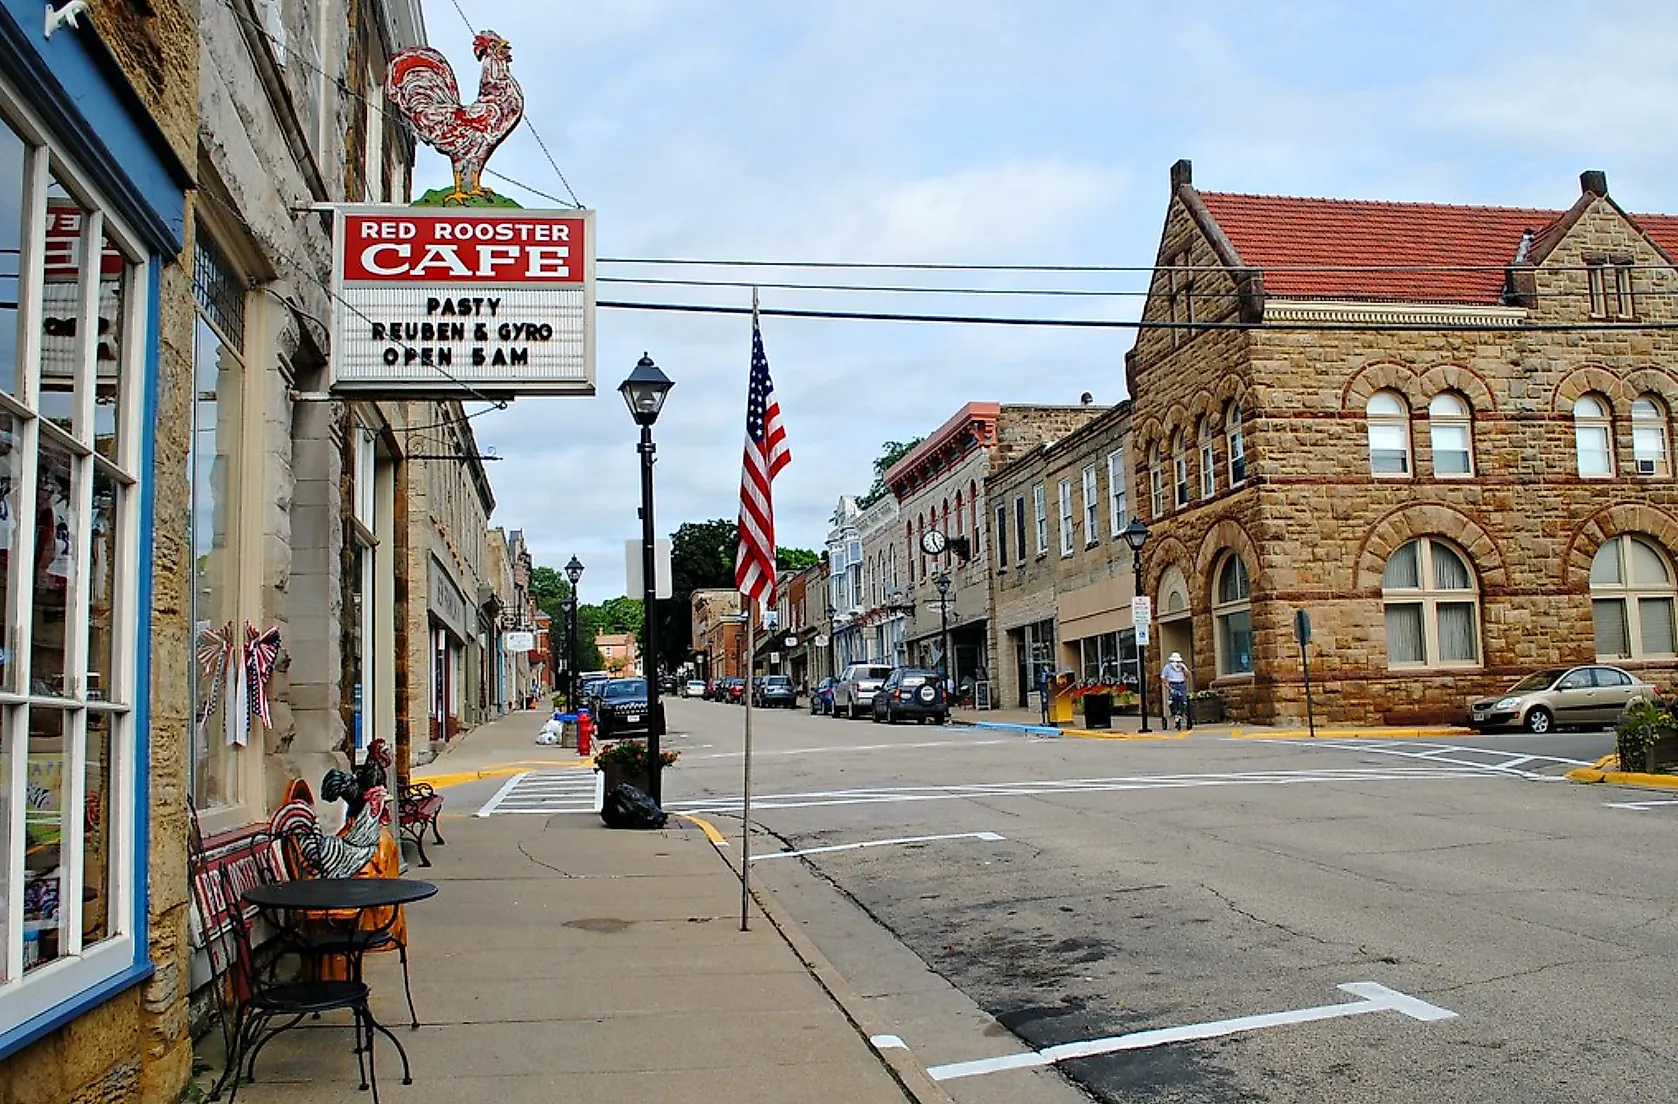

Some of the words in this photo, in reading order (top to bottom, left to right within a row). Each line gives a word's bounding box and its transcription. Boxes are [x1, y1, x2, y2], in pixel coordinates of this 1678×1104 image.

[361, 221, 417, 239] RED
[434, 223, 570, 241] ROOSTER
[360, 242, 570, 278] CAFE
[427, 297, 502, 317] PASTY
[371, 322, 465, 341] REUBEN
[474, 322, 489, 341] &
[498, 322, 553, 342] GYRO
[383, 347, 452, 367] OPEN
